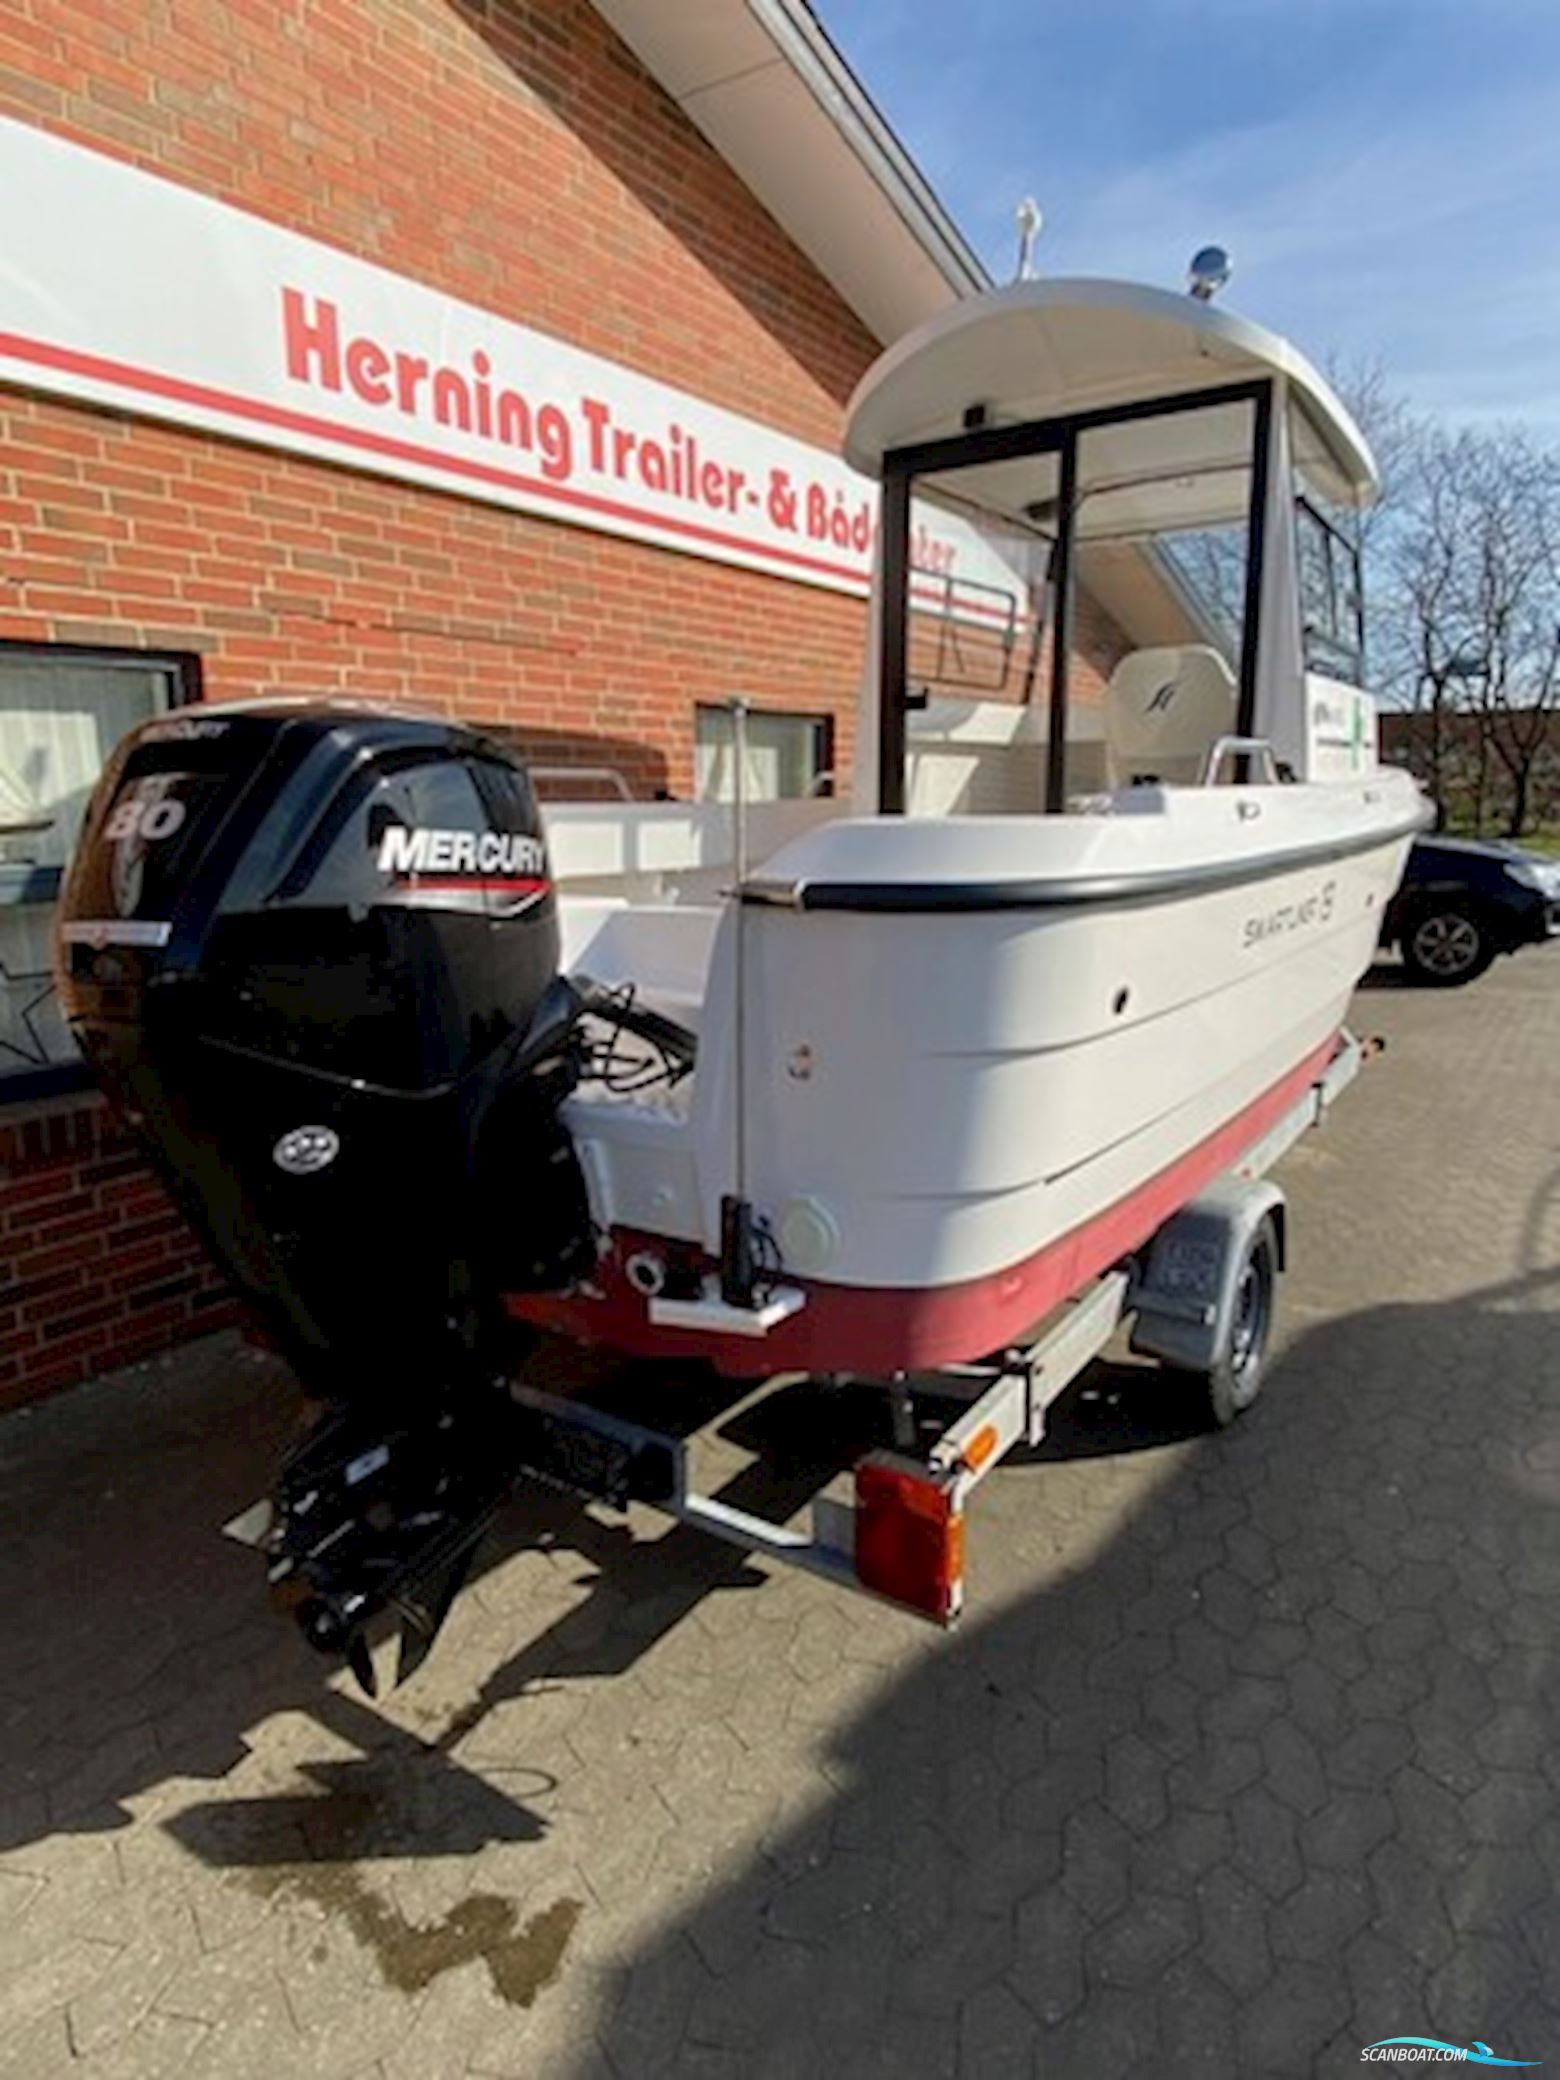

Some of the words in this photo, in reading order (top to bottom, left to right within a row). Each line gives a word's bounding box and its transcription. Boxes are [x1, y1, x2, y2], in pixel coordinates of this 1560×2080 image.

[282, 286, 572, 481] Herning
[582, 396, 759, 514] Trailer-
[767, 466, 798, 534] &
[103, 798, 187, 841] 80
[377, 824, 547, 873] MERCURY
